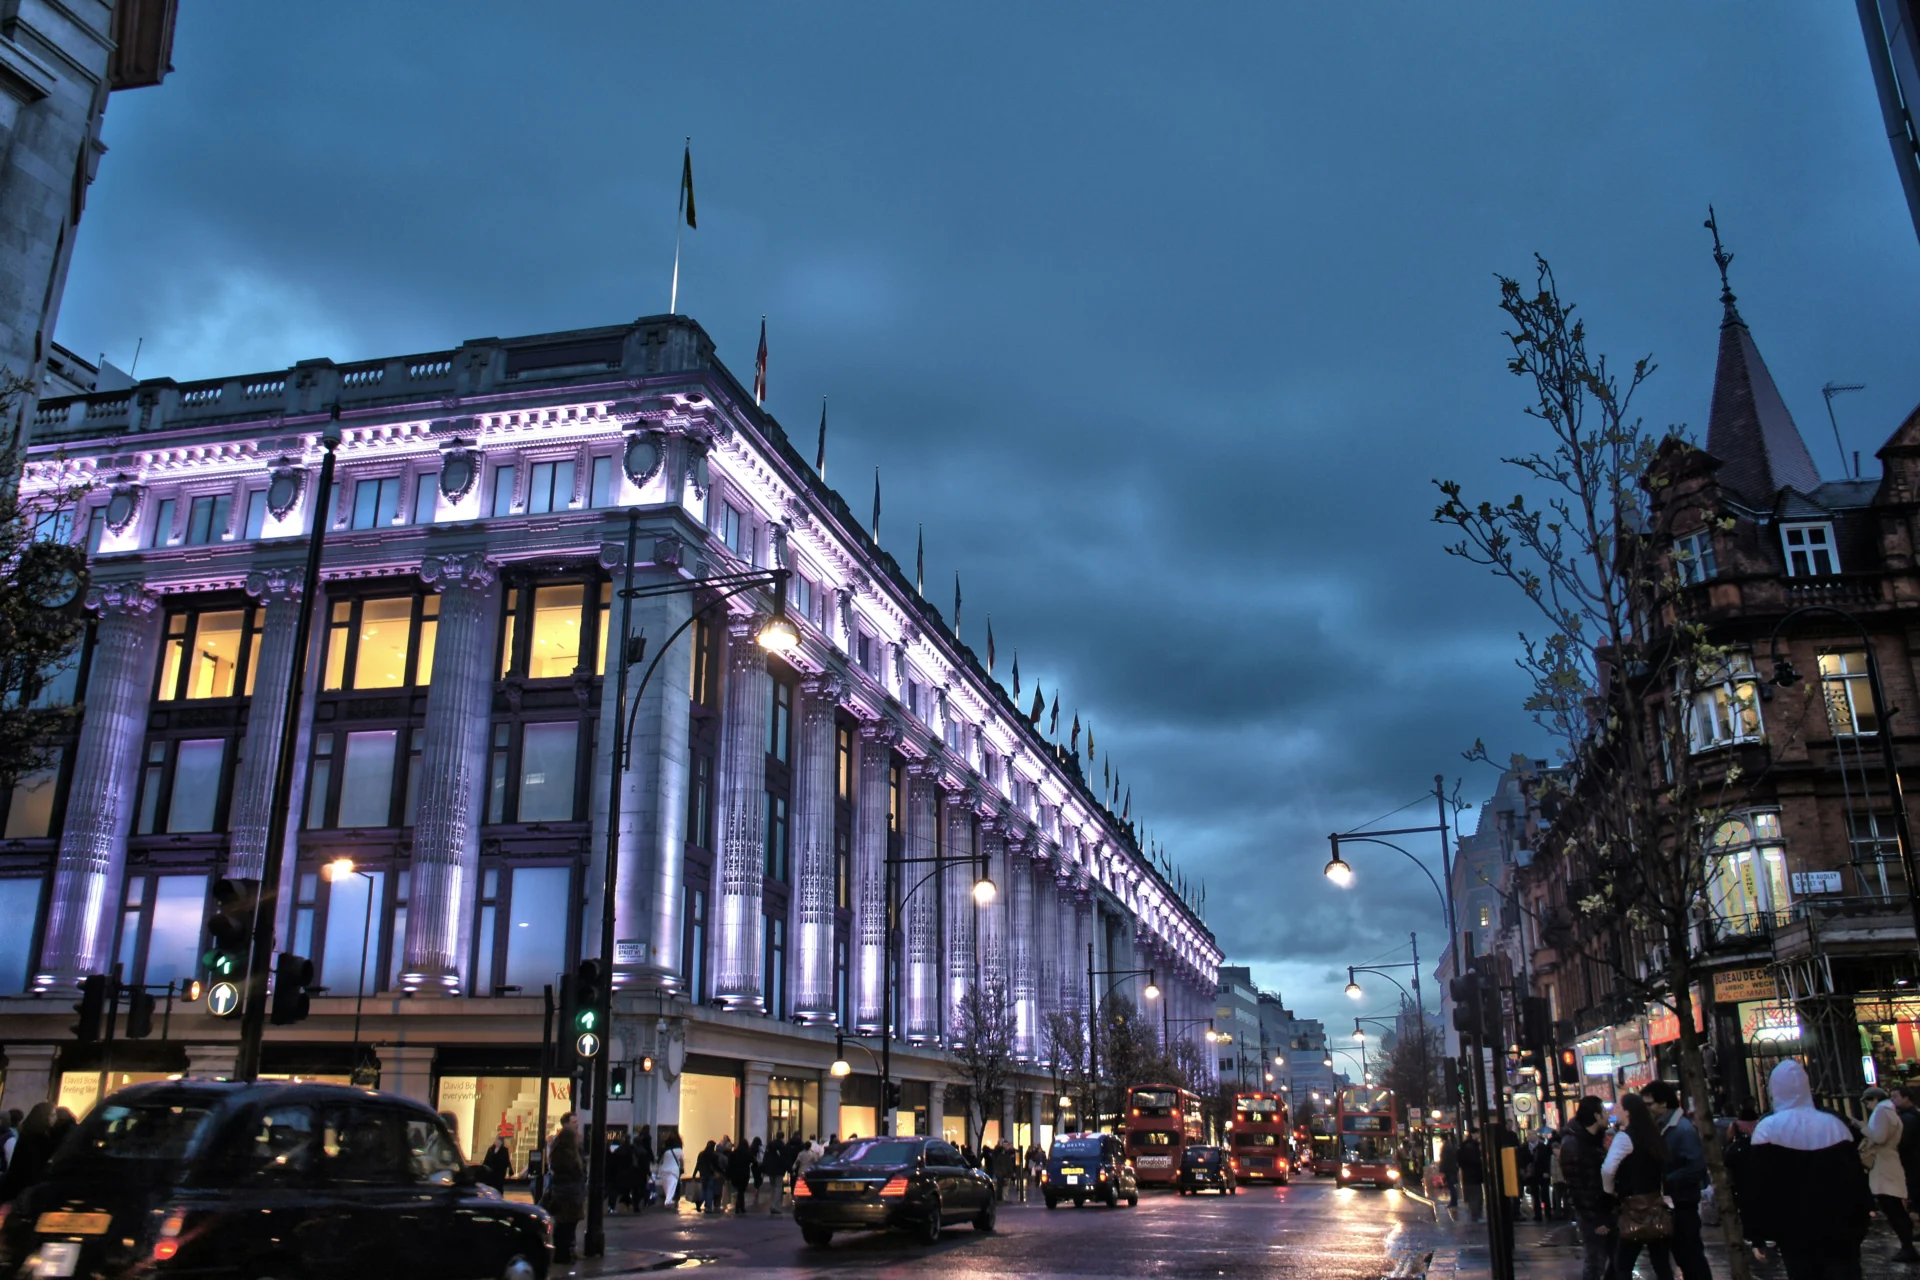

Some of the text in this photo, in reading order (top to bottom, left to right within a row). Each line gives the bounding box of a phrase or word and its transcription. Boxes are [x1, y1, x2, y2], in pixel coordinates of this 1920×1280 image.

[1715, 972, 1742, 985] BUREAU
[1744, 971, 1755, 981] DE
[1742, 1014, 1757, 1036] SALE
[444, 1081, 464, 1090] David
